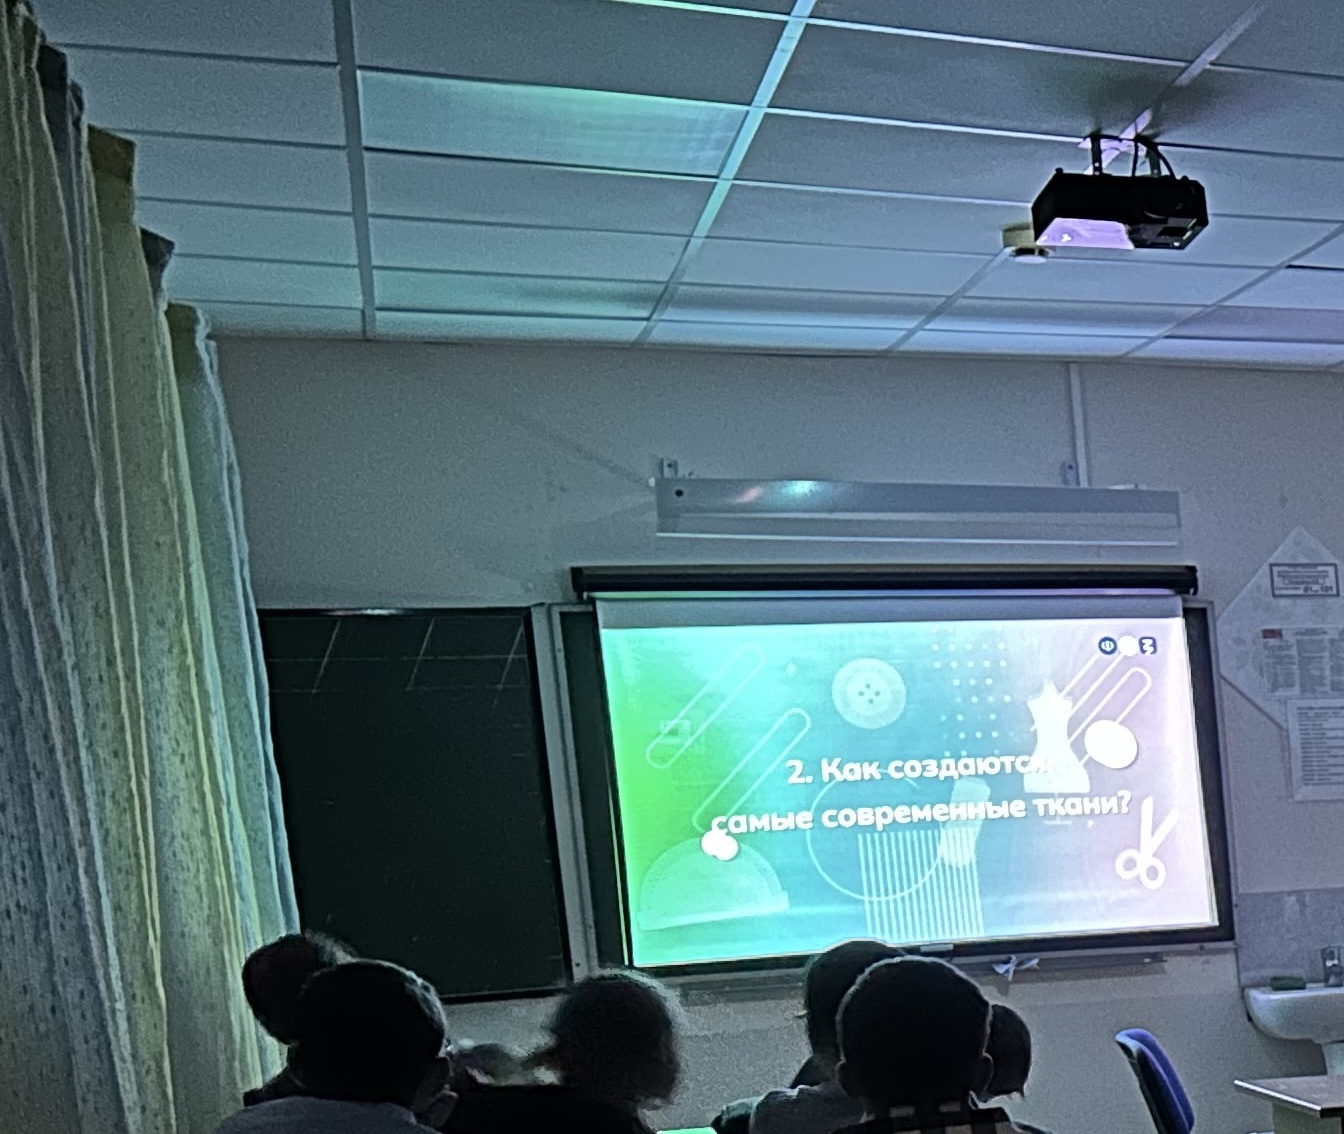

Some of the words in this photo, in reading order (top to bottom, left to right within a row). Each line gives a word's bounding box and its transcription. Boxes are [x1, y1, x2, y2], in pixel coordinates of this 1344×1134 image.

[785, 760, 814, 784] 2.
[820, 757, 882, 783] Как
[711, 807, 814, 834] самые
[822, 799, 1027, 832] современные
[1031, 789, 1132, 817] ткани?
